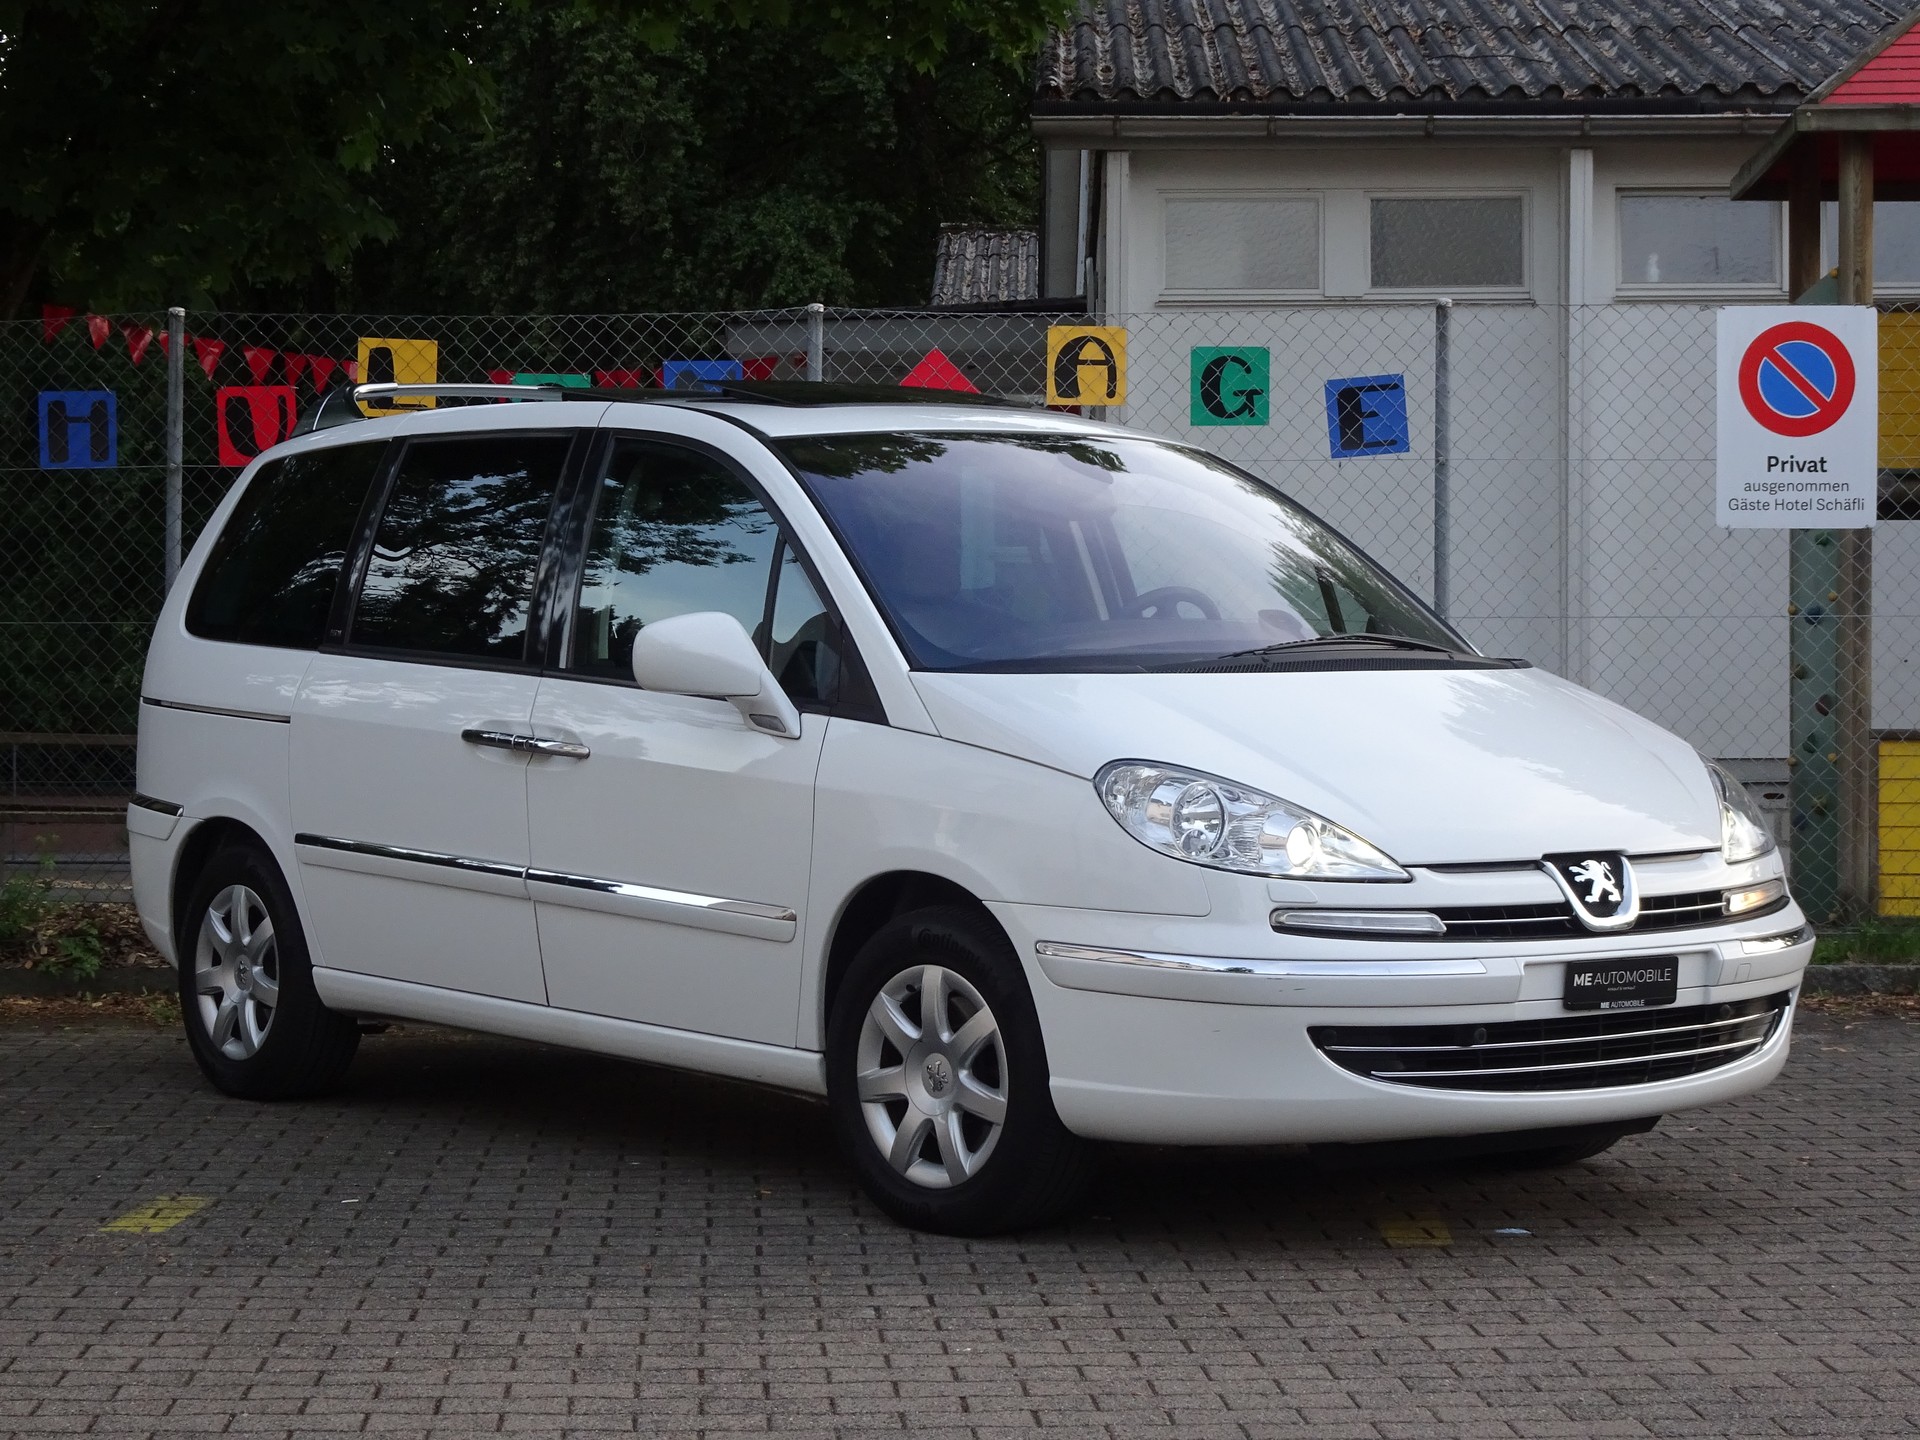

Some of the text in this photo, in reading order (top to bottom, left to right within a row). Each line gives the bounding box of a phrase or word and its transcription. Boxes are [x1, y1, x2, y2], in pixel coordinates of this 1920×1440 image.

[1054, 335, 1117, 399] A
[1201, 355, 1264, 419] G
[1337, 382, 1400, 450] E
[1767, 455, 1827, 473] Privat
[1744, 482, 1849, 495] ausgenommen
[1728, 498, 1865, 511] Gäste Hotel Schäfli
[1573, 968, 1672, 987] ME AUTOMOBILE
[1600, 999, 1645, 1009] ME AUTOMOBILE
